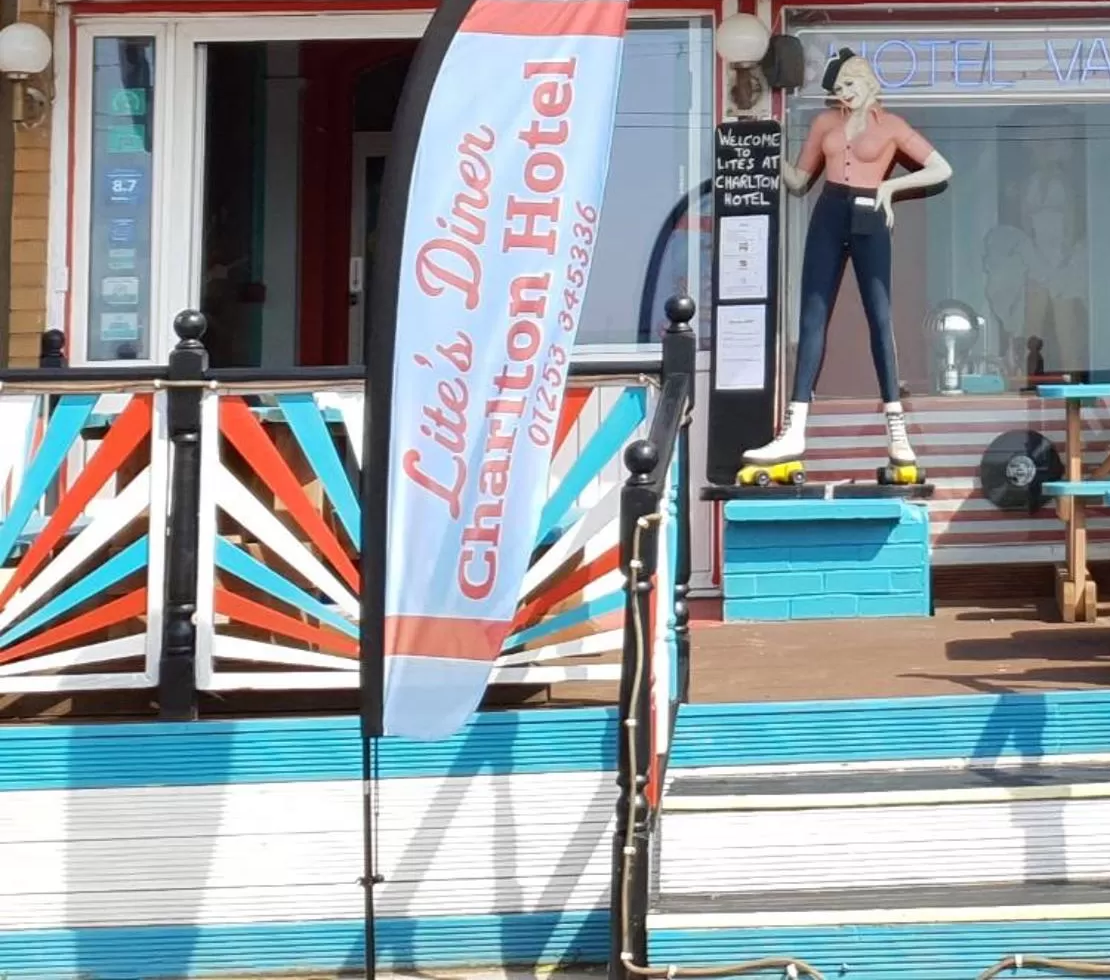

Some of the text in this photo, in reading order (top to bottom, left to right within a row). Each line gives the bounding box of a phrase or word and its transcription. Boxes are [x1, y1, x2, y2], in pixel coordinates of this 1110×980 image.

[827, 38, 1016, 88] OTEL
[717, 127, 781, 147] WELCOME
[734, 147, 751, 158] TO
[717, 155, 781, 171] LITES AT
[715, 174, 780, 190] CHARLTON
[724, 191, 771, 206] HOTEL
[402, 123, 496, 520] Lite's Diner
[458, 56, 577, 601] Charlton Hotel
[528, 200, 598, 447] 01253 345336
